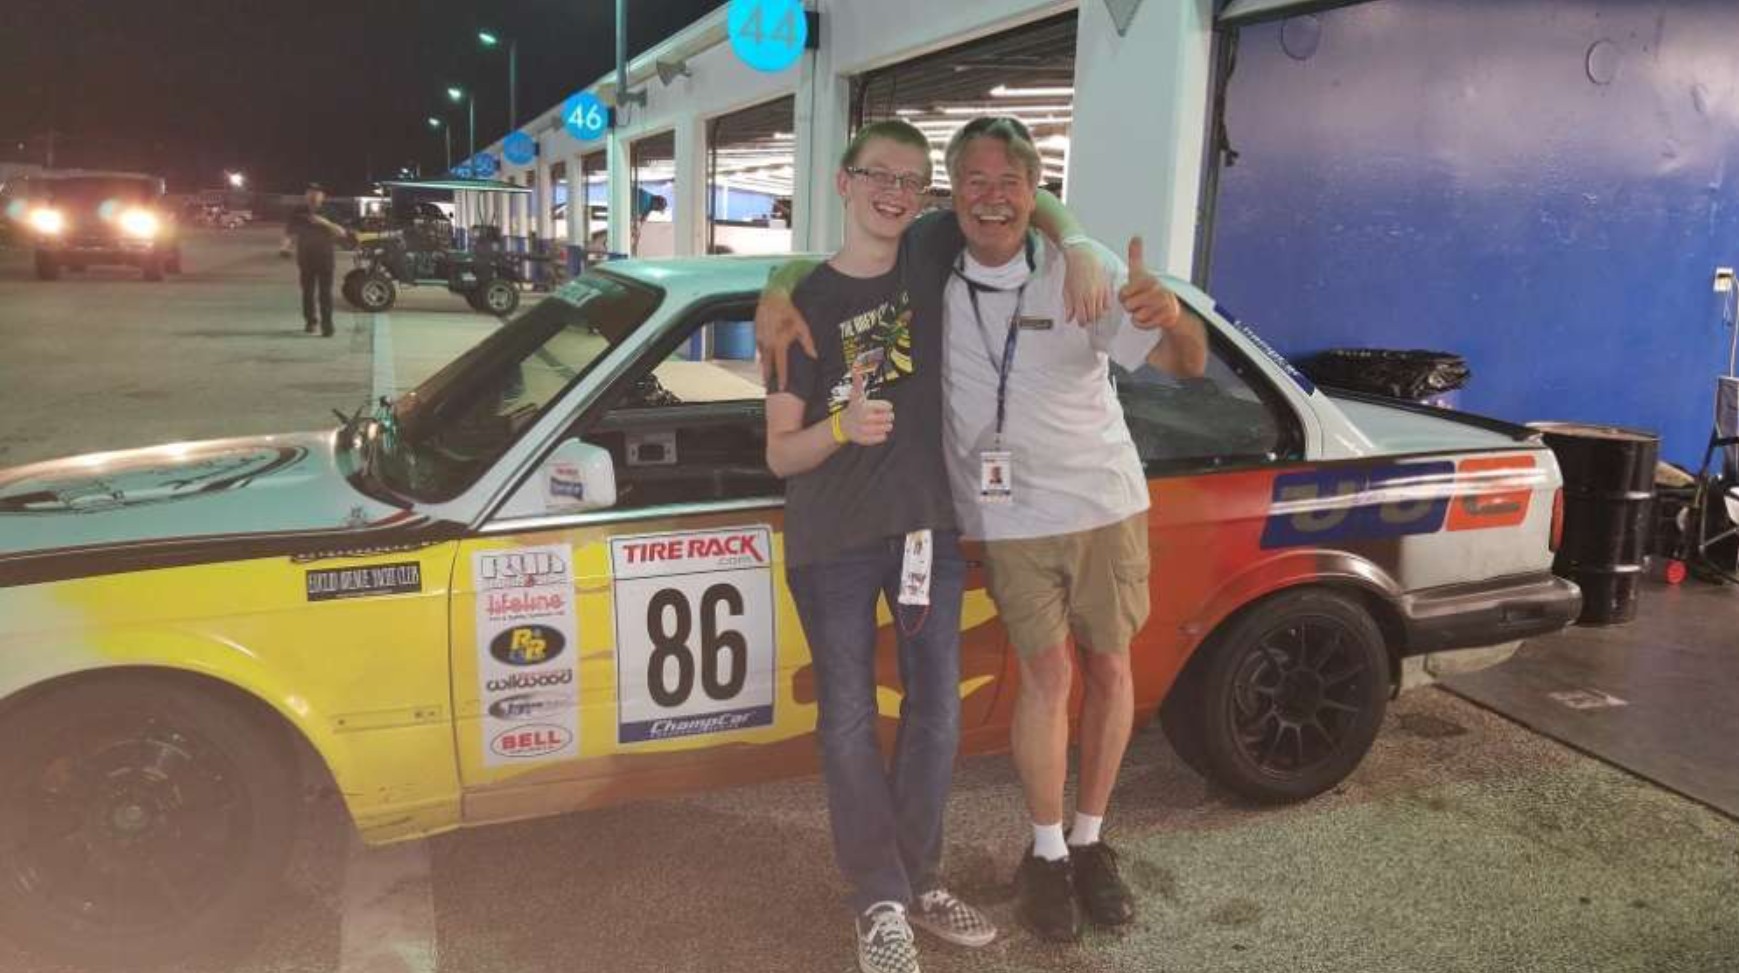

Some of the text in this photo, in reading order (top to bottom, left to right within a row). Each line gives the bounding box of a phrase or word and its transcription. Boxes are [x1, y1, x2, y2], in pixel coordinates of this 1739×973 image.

[739, 3, 799, 51] 44
[567, 103, 601, 131] 46
[623, 534, 764, 564] TIRE RACK
[647, 583, 748, 708] 86
[502, 730, 561, 749] BELL
